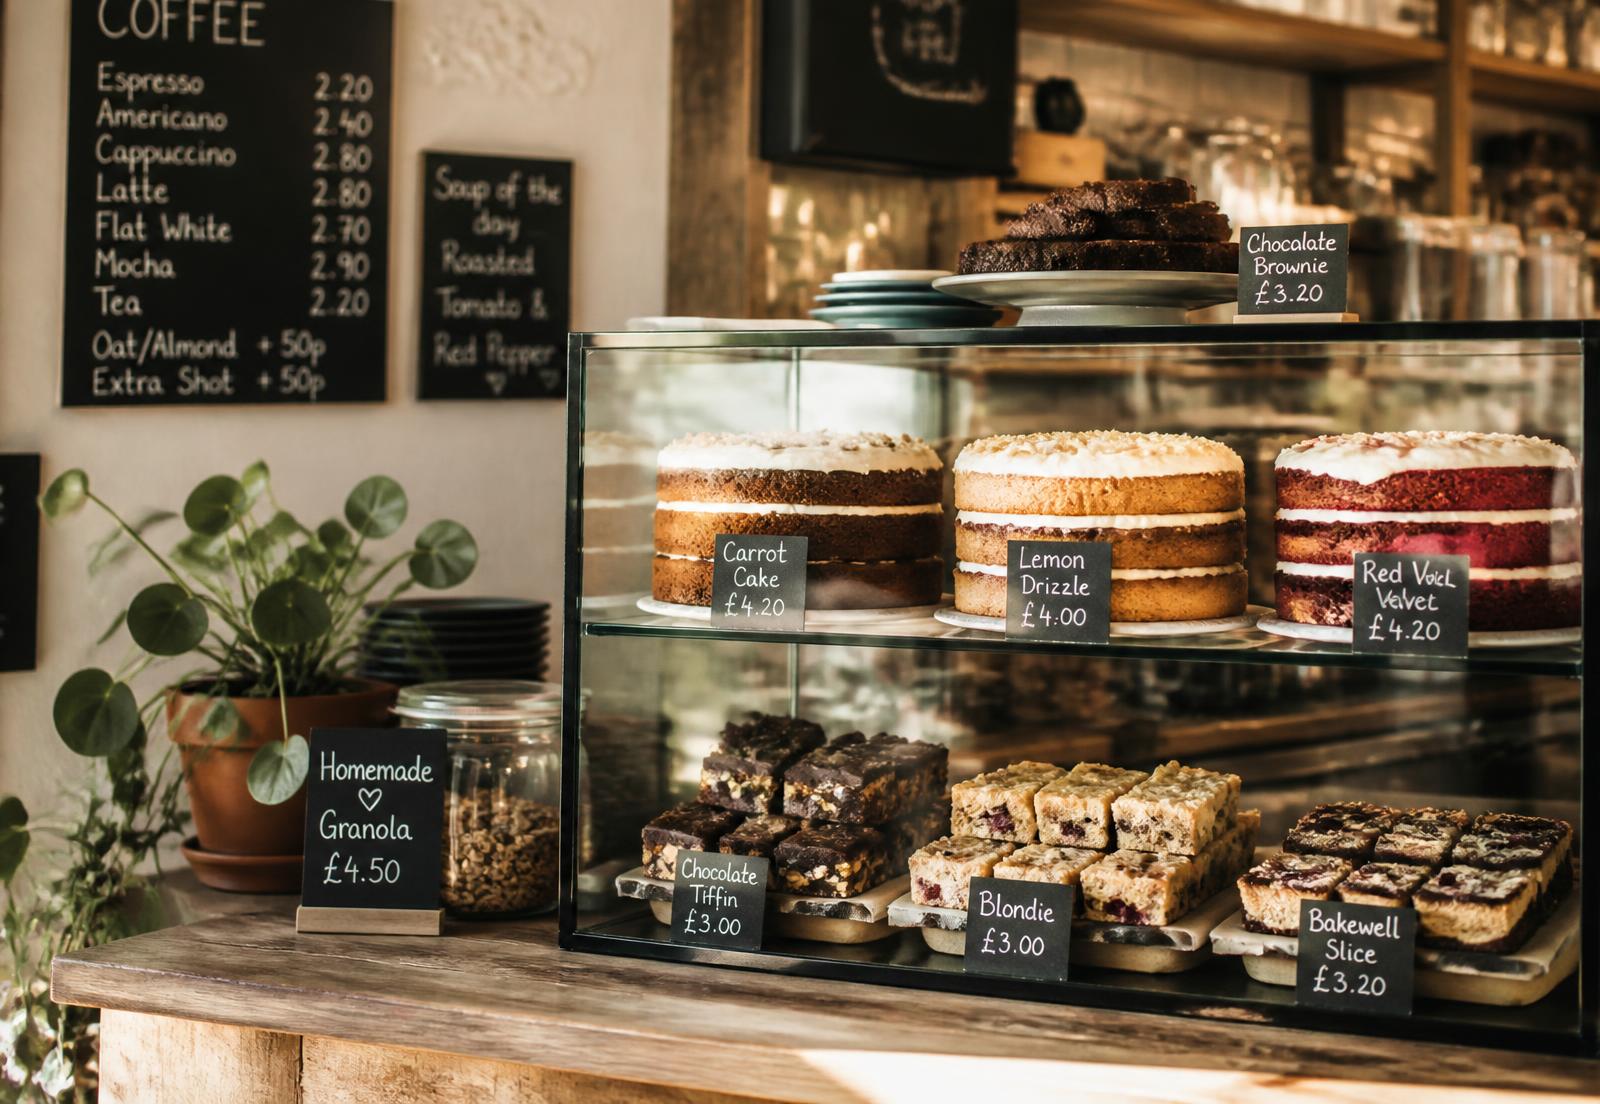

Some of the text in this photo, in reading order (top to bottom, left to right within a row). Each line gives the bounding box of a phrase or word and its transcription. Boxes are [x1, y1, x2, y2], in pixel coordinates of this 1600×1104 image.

[97, 0, 267, 47] COFFEE
[97, 60, 375, 102] Espresso 2.20
[96, 99, 375, 138] Americano 2.40
[95, 133, 374, 173] Cappuccino 2.80
[96, 172, 374, 209] Latte 2.80
[496, 170, 524, 210] of
[528, 174, 563, 206] the
[95, 210, 373, 246] Flat White 2.70
[472, 208, 521, 244] day
[94, 247, 372, 282] Mocha 2.90
[441, 238, 536, 276] Roasted
[1253, 256, 1329, 276] Brownie
[92, 284, 371, 318] Tea 2.20
[434, 284, 522, 320] Tomato
[1255, 279, 1324, 306] £3.20
[92, 327, 238, 366] Oat/Almond
[280, 329, 327, 368] 50p
[433, 330, 478, 368] Red
[92, 366, 165, 398] Extra
[177, 366, 236, 396] Shot
[279, 365, 326, 403] 50p
[723, 540, 788, 563] Carrot
[1019, 545, 1086, 570] Lemon
[733, 566, 780, 588] Cake
[1019, 573, 1091, 596] Drizzle
[1362, 559, 1403, 584] Red
[724, 591, 785, 618] £4.20
[1368, 613, 1441, 642] £4.20
[319, 750, 434, 783] Homemade
[318, 808, 414, 841] Granola
[322, 851, 401, 885] £4.50
[681, 857, 758, 886] Chocolate
[689, 884, 739, 911] Tiffin
[979, 890, 1055, 923] Blondie
[683, 908, 742, 936] £3.00
[1308, 907, 1401, 939] Bakewell
[980, 927, 1045, 957] £3.00
[1324, 938, 1378, 965] Slice
[1312, 964, 1387, 997] £3.20
